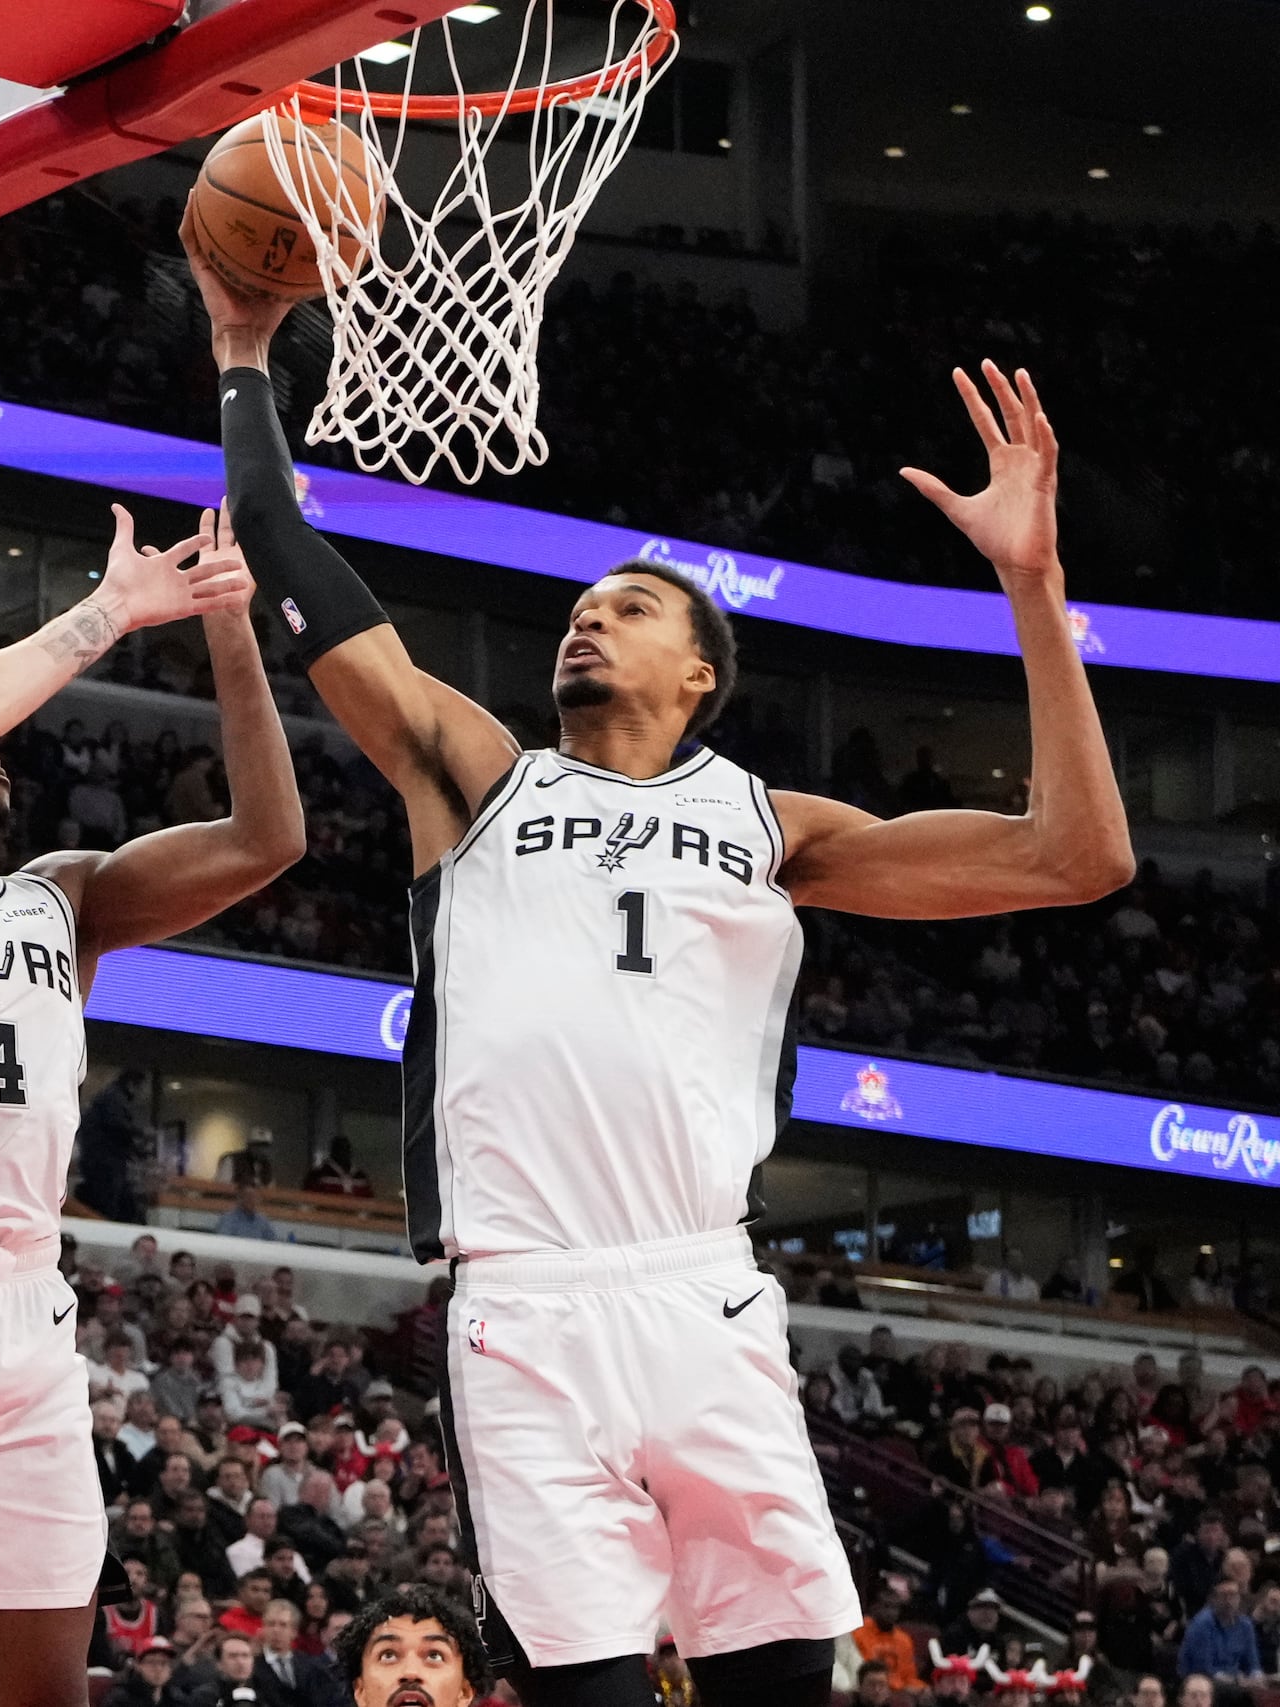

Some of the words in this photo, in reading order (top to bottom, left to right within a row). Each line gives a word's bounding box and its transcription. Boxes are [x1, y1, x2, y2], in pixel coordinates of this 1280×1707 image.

[516, 812, 754, 886] SPURS
[5, 907, 47, 918] LEDGER
[612, 888, 658, 979] 1
[1150, 1104, 1231, 1162] Crown
